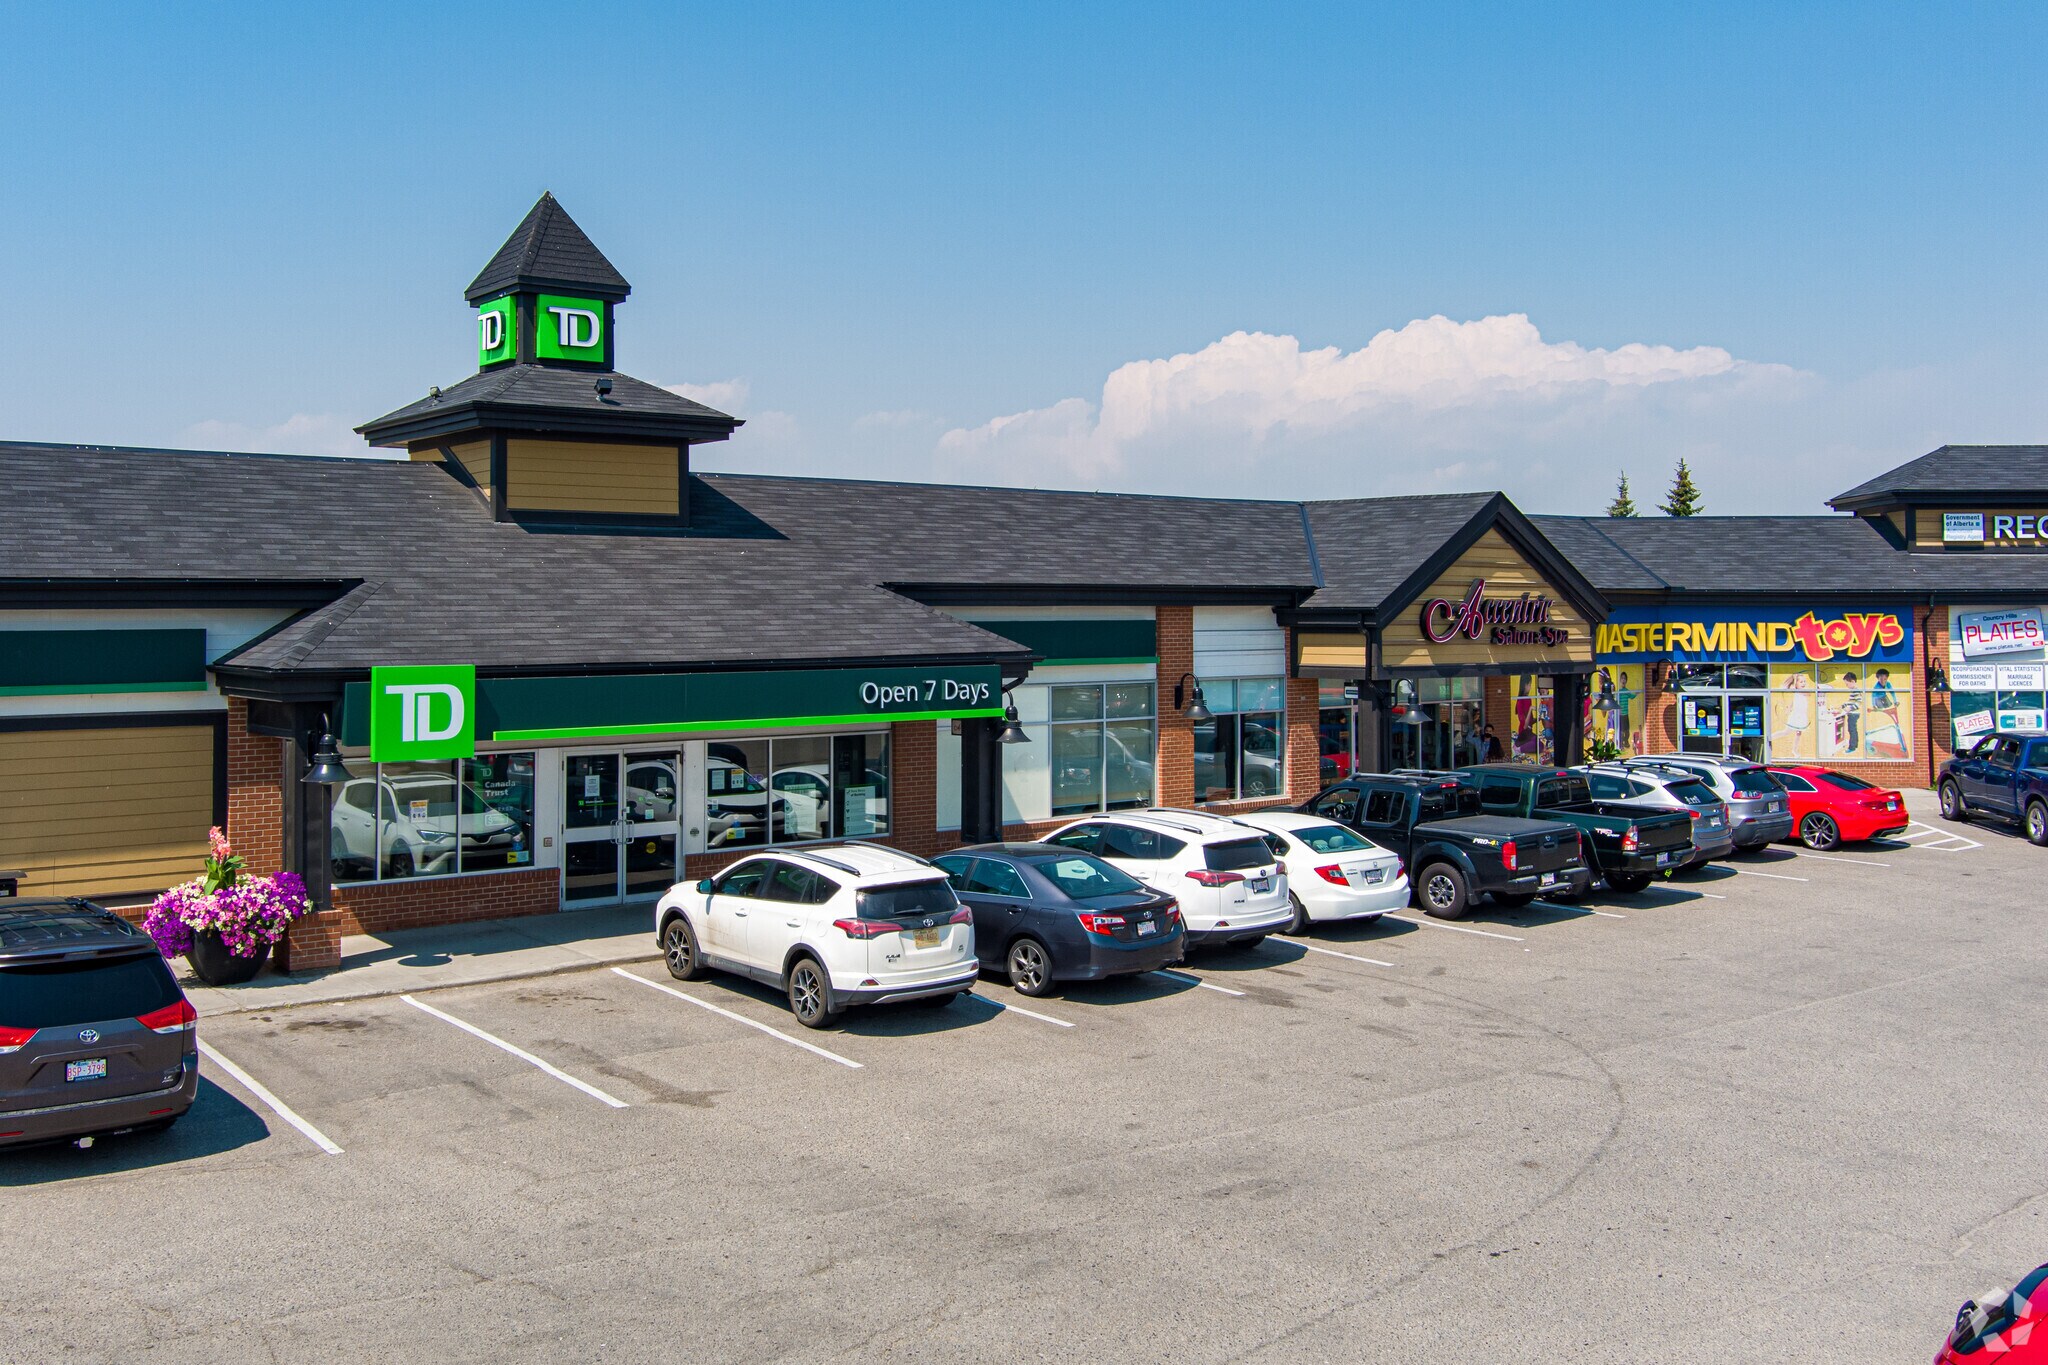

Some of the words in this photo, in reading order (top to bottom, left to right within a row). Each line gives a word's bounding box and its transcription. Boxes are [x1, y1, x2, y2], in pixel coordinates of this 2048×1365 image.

[477, 310, 502, 350] TD
[548, 306, 600, 347] TD
[1422, 578, 1555, 643] Accentric
[1495, 626, 1537, 645] Salon
[1545, 626, 1569, 647] Spa
[1791, 610, 1904, 662] toys
[1965, 619, 2038, 644] PLATES
[861, 682, 918, 708] Open
[923, 680, 936, 701] 7
[944, 679, 989, 705] Days
[385, 684, 465, 742] TD
[1956, 715, 1990, 730] PLATES
[480, 768, 492, 777] TD
[485, 780, 516, 789] Canada
[485, 789, 509, 797] Trust
